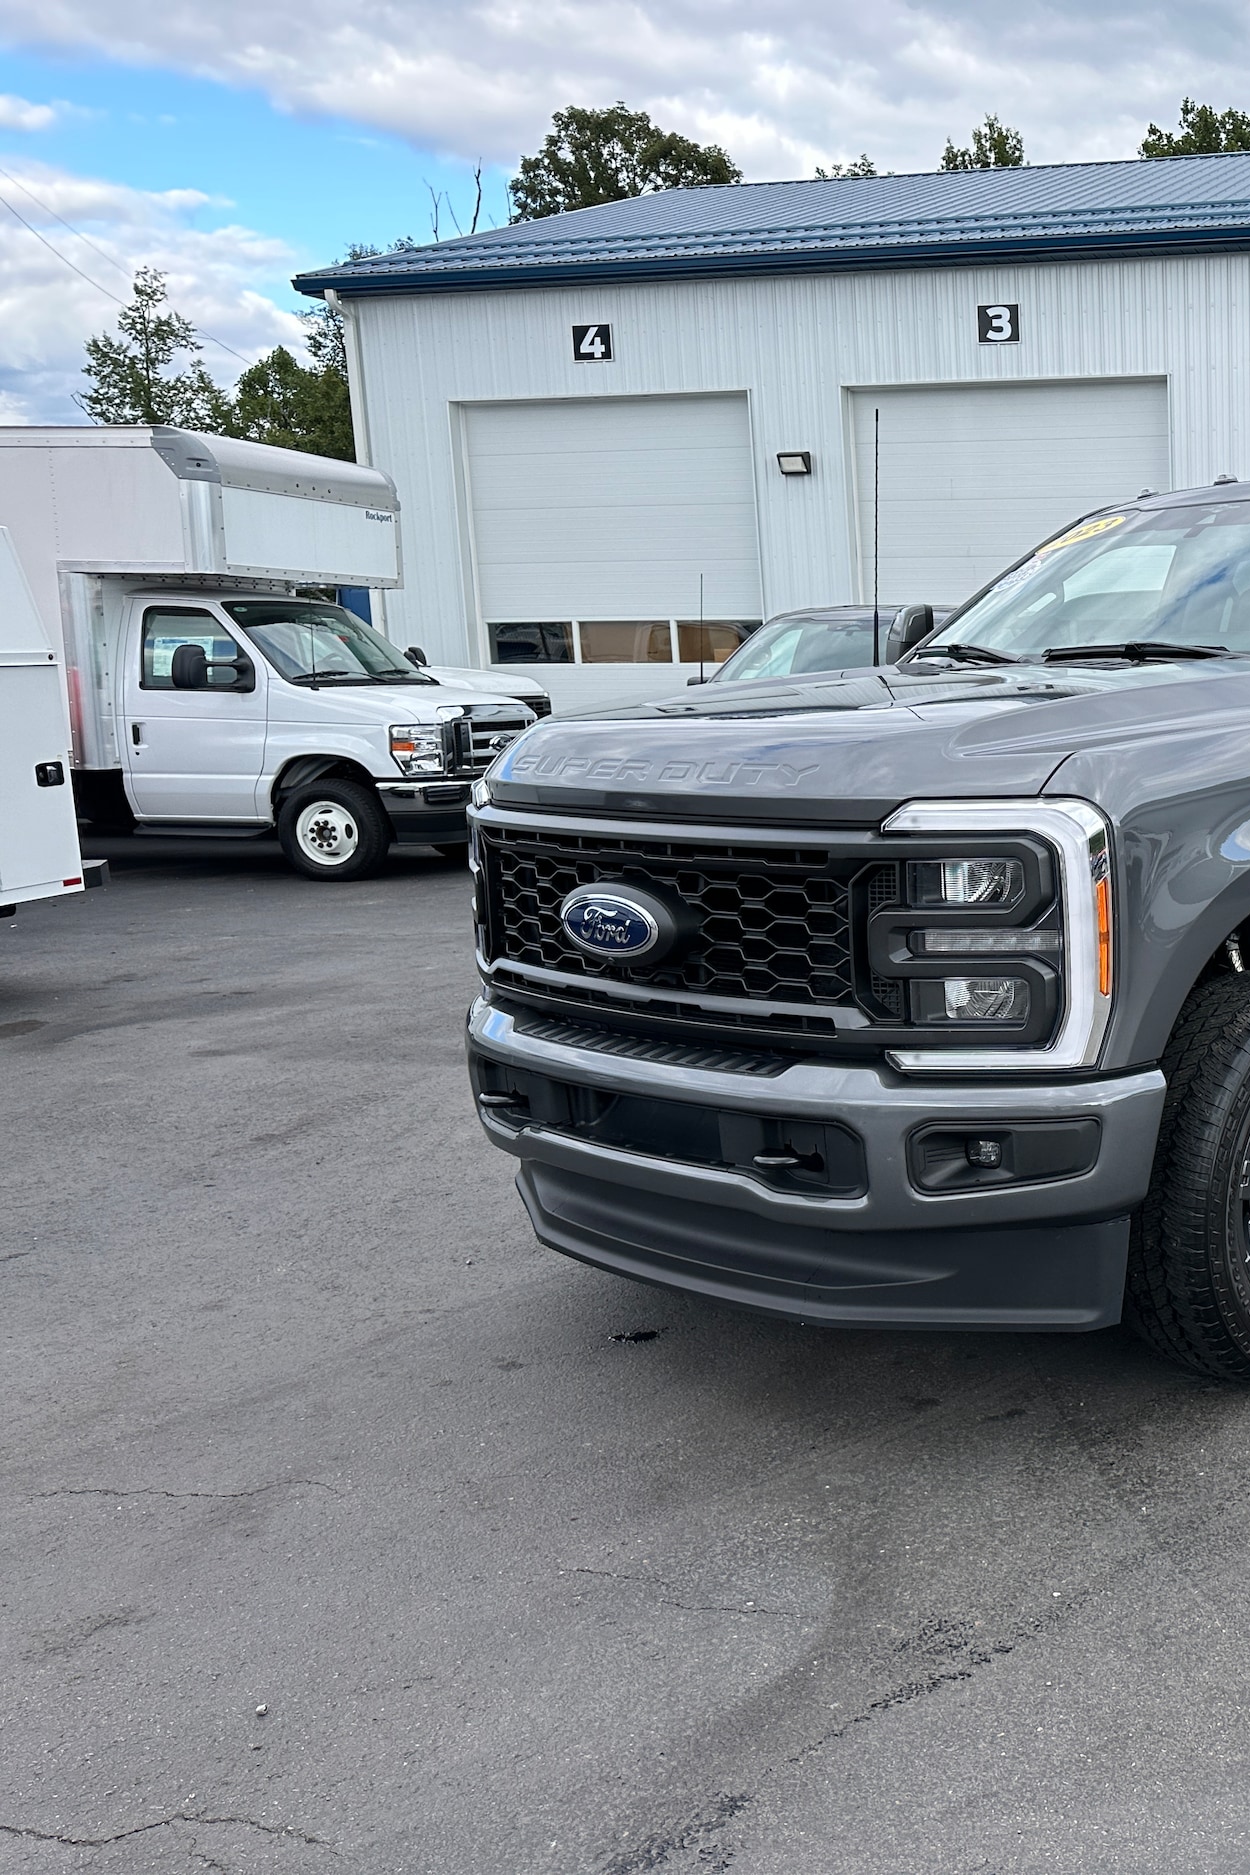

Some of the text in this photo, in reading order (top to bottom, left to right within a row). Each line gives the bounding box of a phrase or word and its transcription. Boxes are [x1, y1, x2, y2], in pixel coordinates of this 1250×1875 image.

[986, 306, 1012, 341] 3
[580, 327, 605, 358] 4
[366, 510, 393, 523] Rockport
[511, 754, 821, 787] SUPER DUTY
[581, 905, 631, 944] Ford
